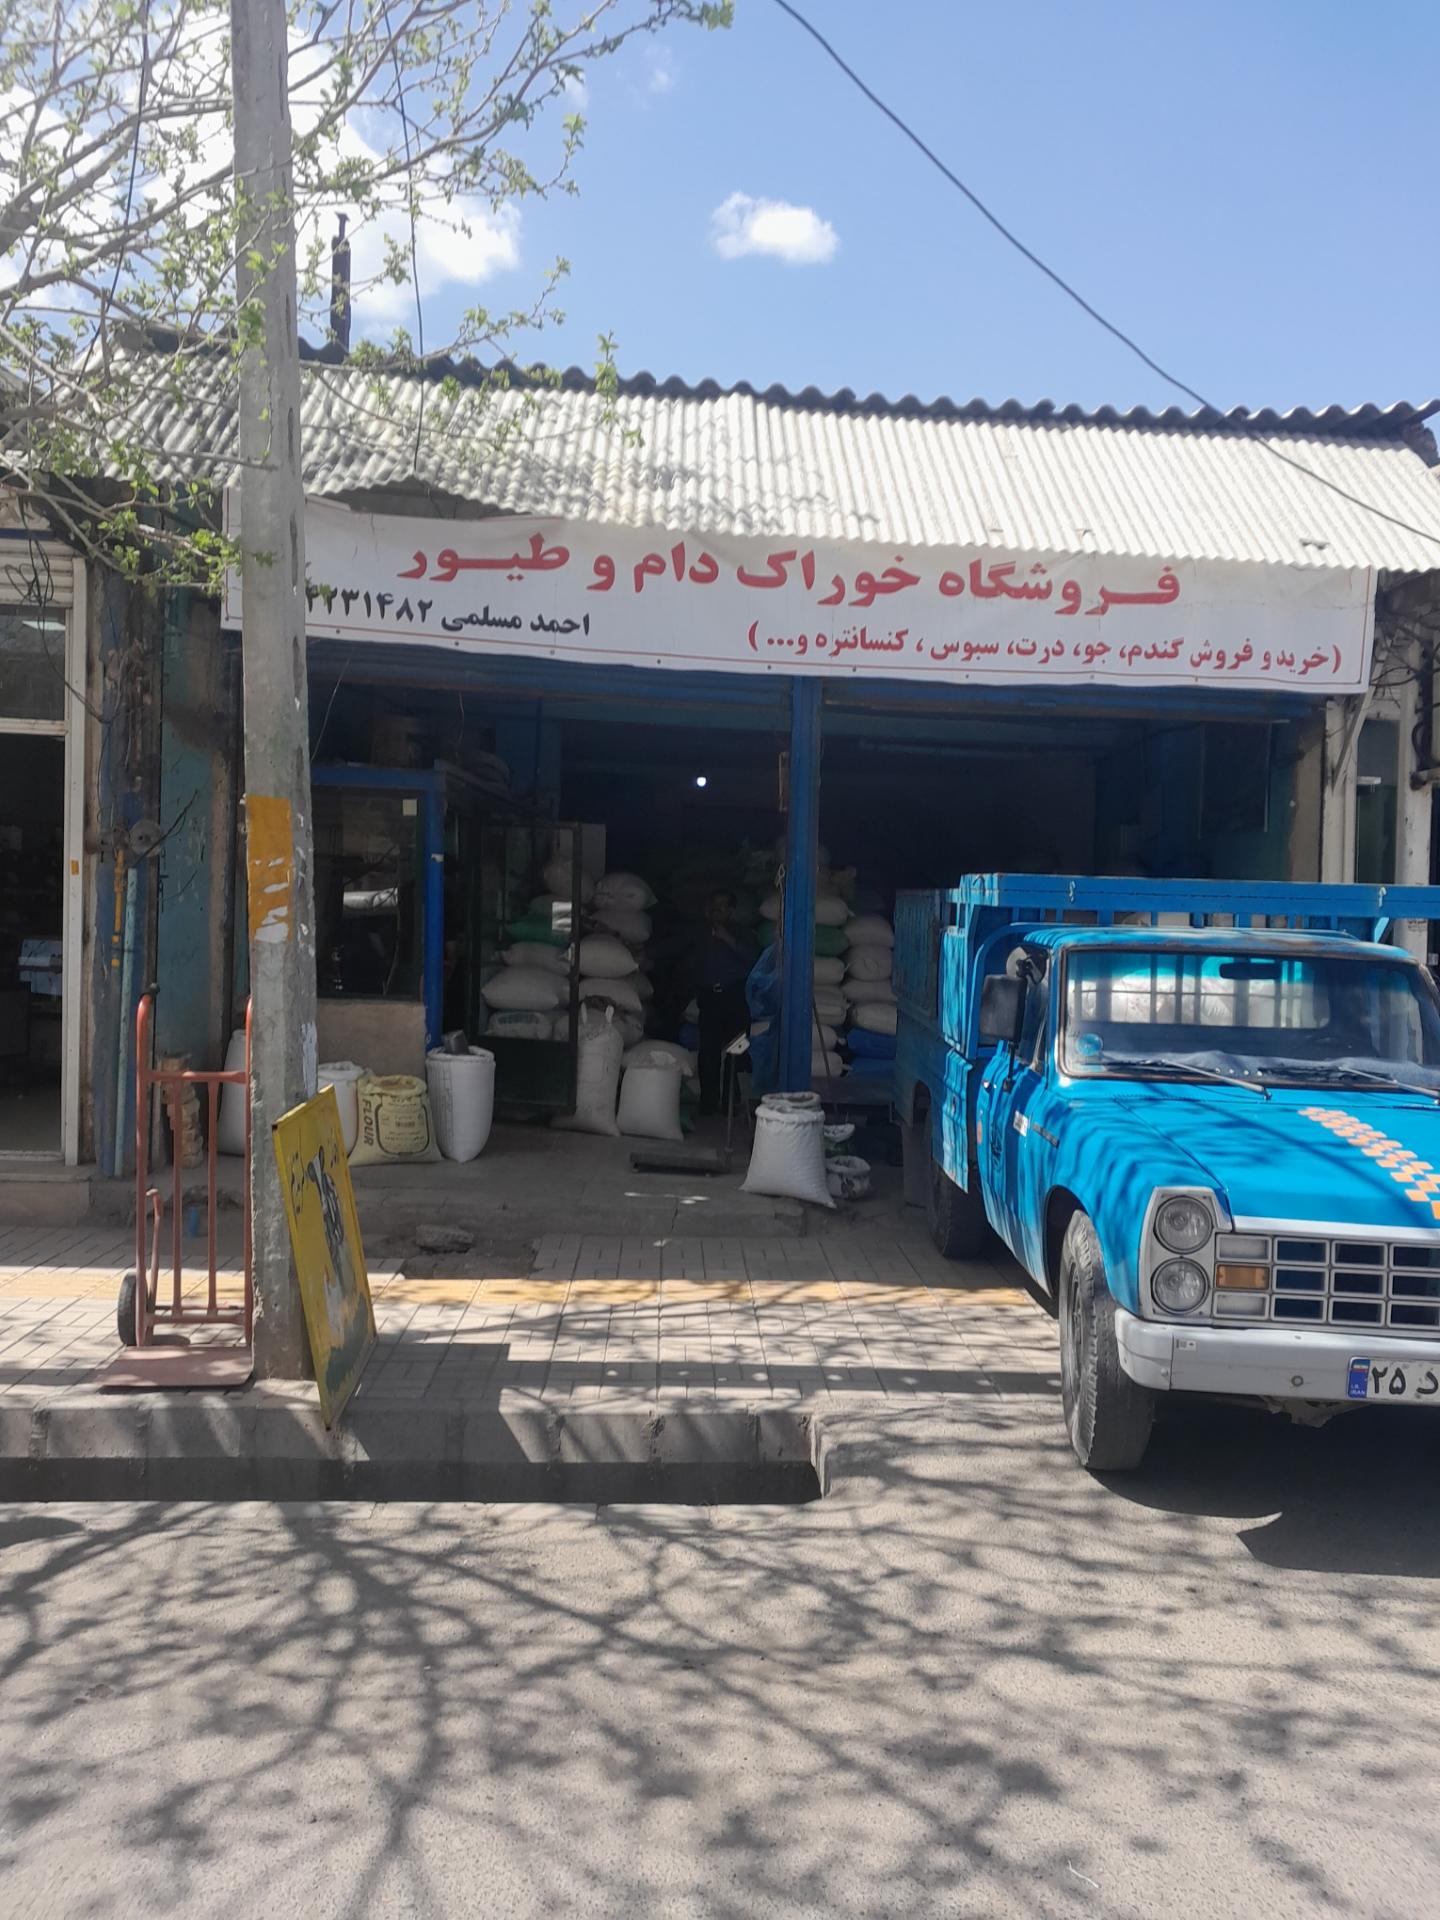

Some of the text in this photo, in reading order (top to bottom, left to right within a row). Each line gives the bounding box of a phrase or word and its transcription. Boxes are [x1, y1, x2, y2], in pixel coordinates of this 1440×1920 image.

[396, 531, 1181, 616] فروشگاه خوراک دام و طیور
[441, 604, 522, 632] مسلمی
[530, 613, 590, 636] احمد
[814, 625, 909, 657] کنسانتره
[1190, 637, 1254, 670] فروش
[1259, 650, 1271, 671] و
[362, 1098, 375, 1147] FLOUR
[1372, 1366, 1407, 1395] ۲۵
